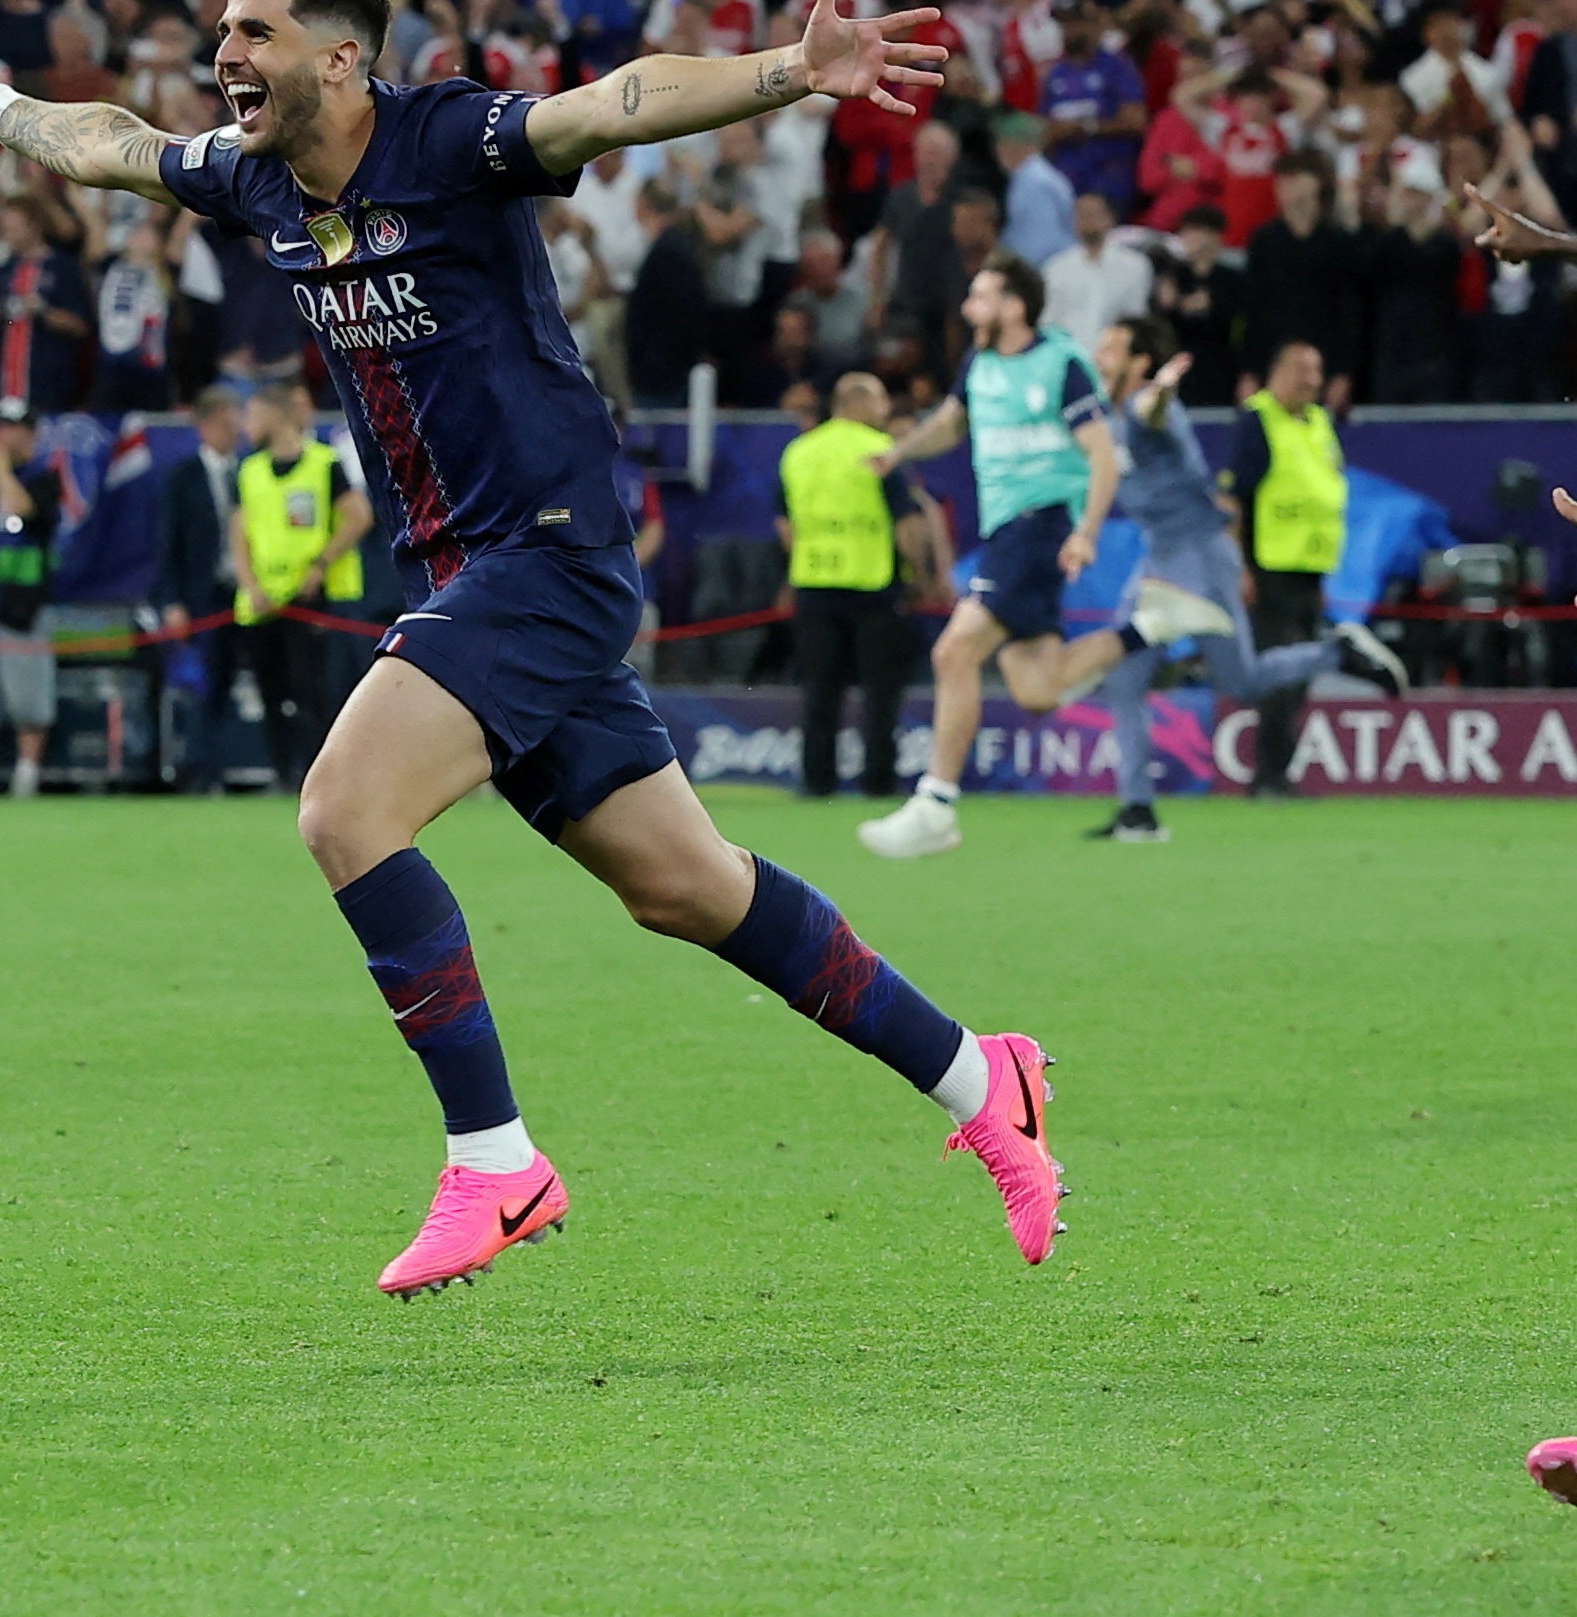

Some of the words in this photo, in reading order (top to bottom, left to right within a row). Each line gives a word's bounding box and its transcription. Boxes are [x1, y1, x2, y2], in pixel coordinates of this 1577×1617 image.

[482, 90, 525, 172] BEYON
[292, 272, 429, 333] QATAR
[329, 311, 438, 351] AIRWAYS
[975, 726, 1164, 777] FINA
